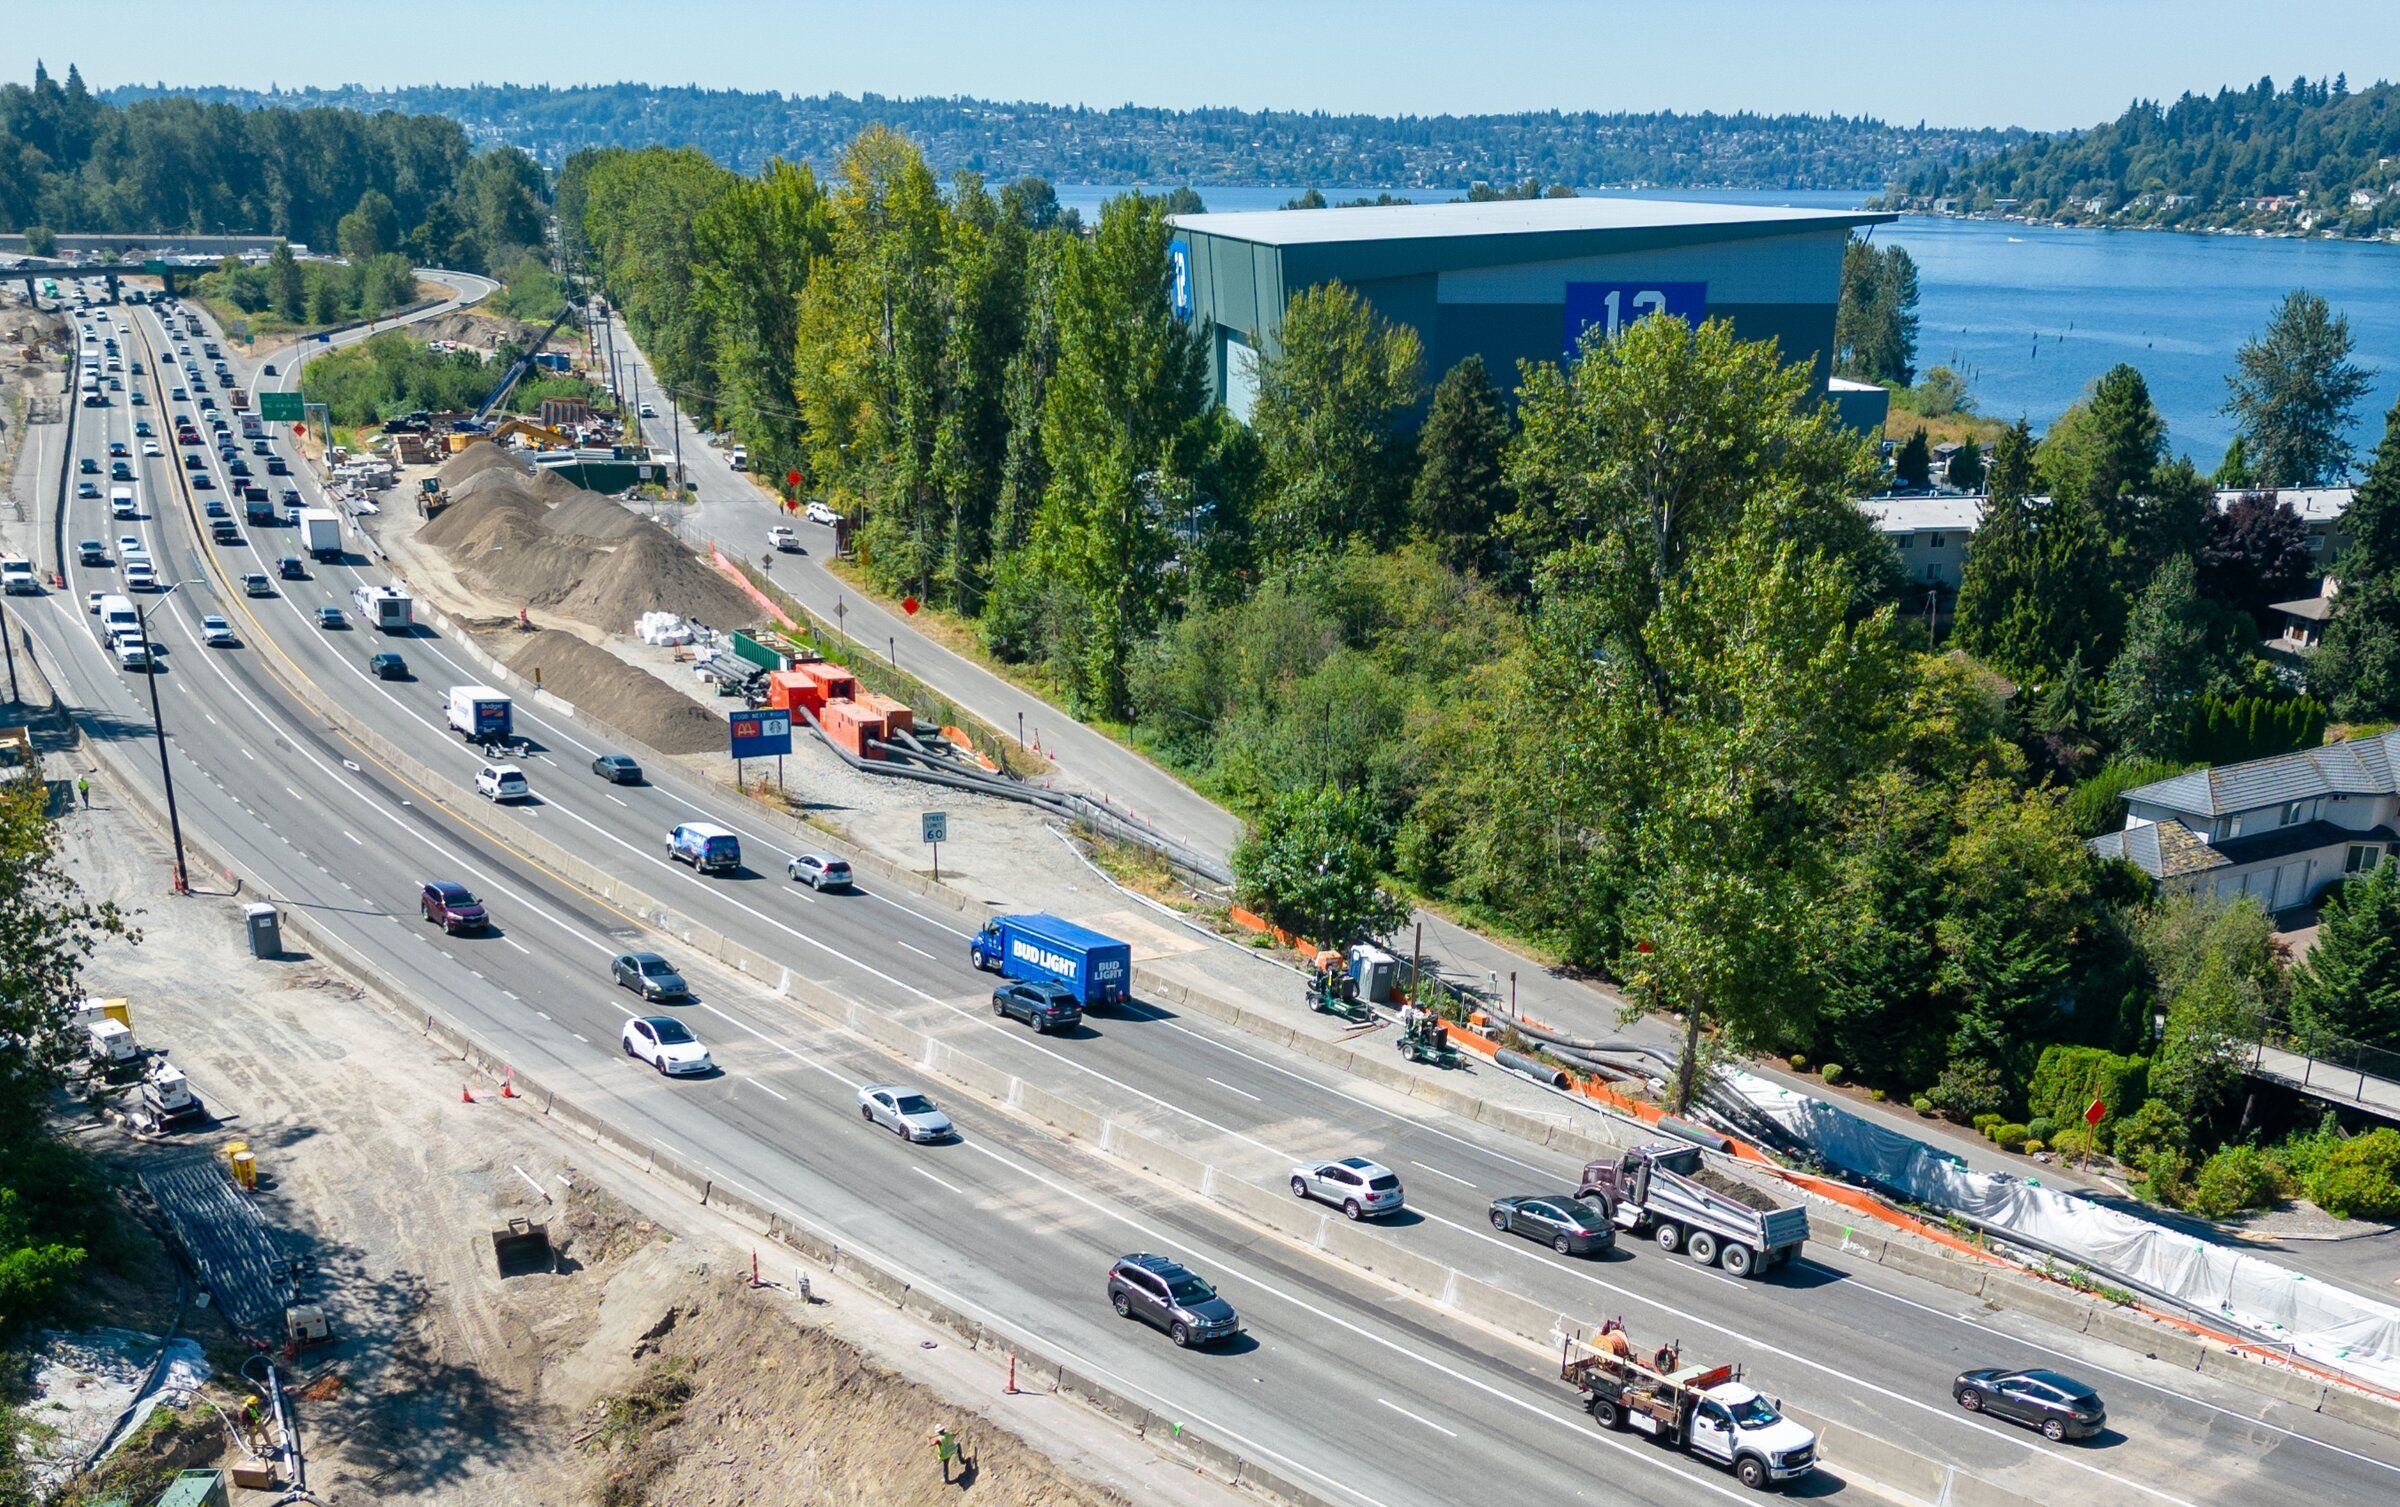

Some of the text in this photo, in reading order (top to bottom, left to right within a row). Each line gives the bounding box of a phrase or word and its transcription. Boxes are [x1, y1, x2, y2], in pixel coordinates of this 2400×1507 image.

[927, 829, 943, 839] 60
[1013, 939, 1078, 979] BUD LIGHT
[1098, 961, 1120, 971] BUD
[1094, 969, 1123, 980] LIGHT
